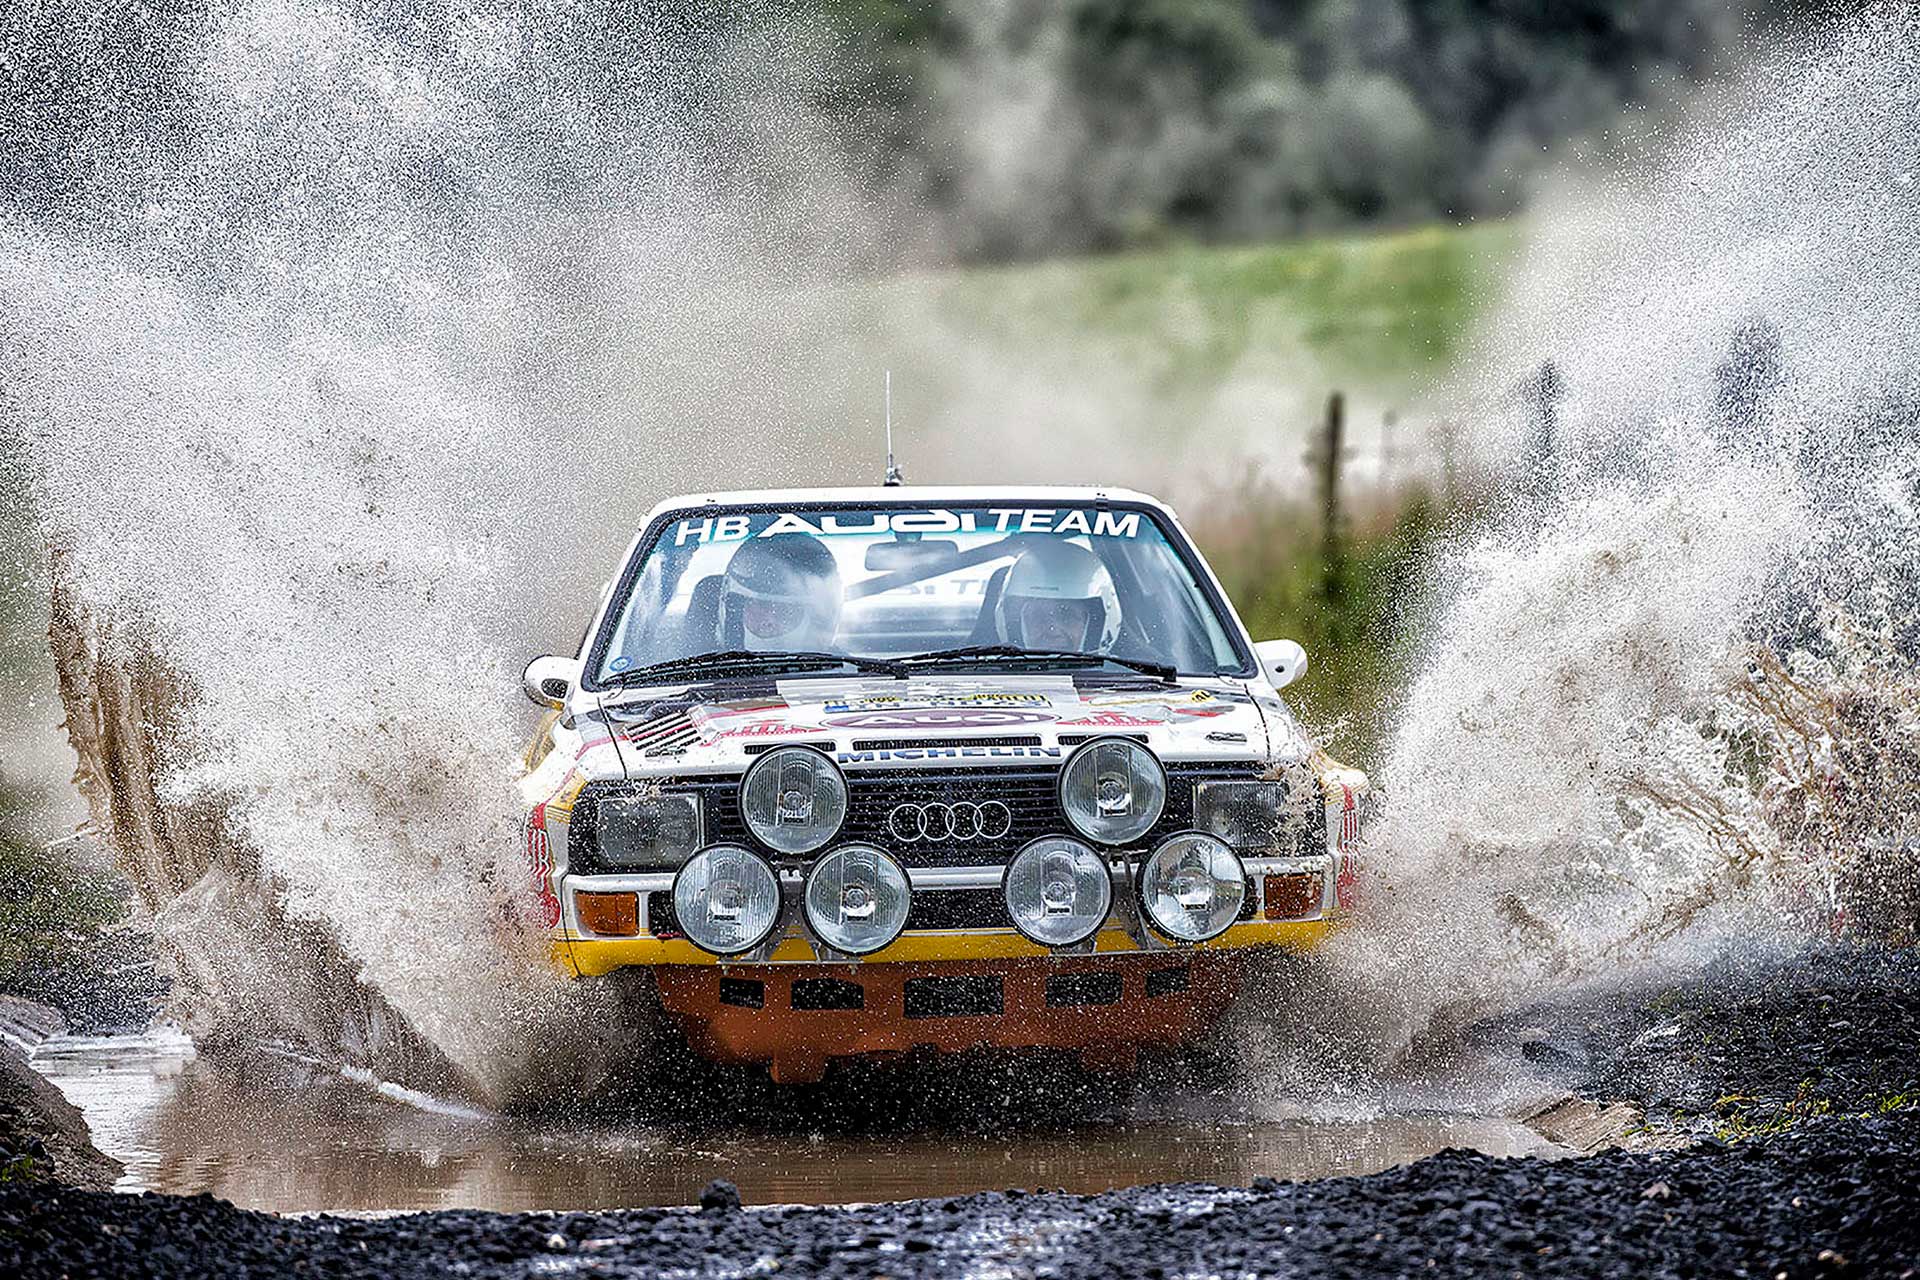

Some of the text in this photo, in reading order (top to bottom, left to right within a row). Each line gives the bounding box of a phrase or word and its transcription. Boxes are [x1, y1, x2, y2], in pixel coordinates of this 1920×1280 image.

[674, 516, 750, 546] HB
[988, 508, 1140, 538] TEAM
[848, 714, 1041, 726] AUDI
[837, 747, 1061, 764] MICHELIN
